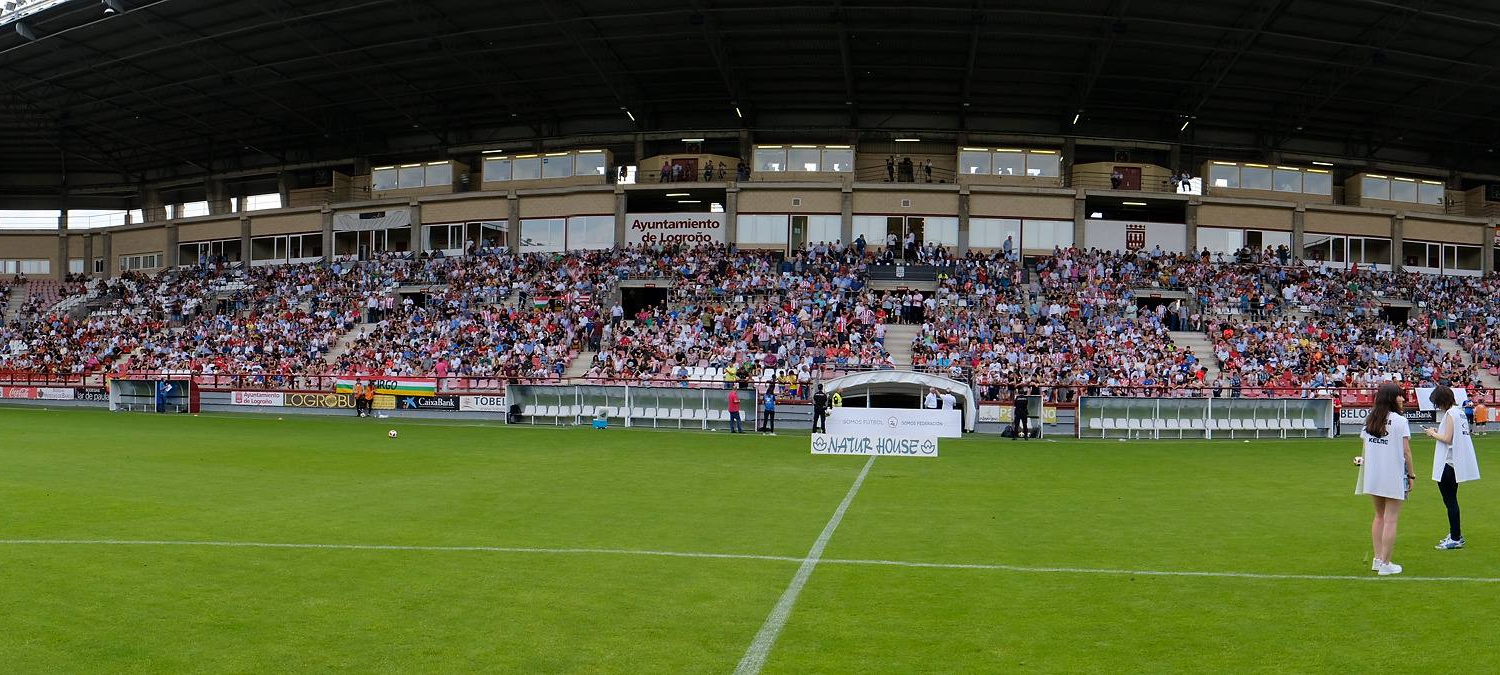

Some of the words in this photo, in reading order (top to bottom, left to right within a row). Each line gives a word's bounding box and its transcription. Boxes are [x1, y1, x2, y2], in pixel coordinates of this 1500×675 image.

[632, 218, 720, 232] Ayuntamiento
[641, 232, 657, 242] de
[660, 232, 712, 243] Logroño
[418, 397, 455, 406] CaixaBank
[827, 436, 872, 454] NATUR
[876, 437, 920, 455] HOUSE
